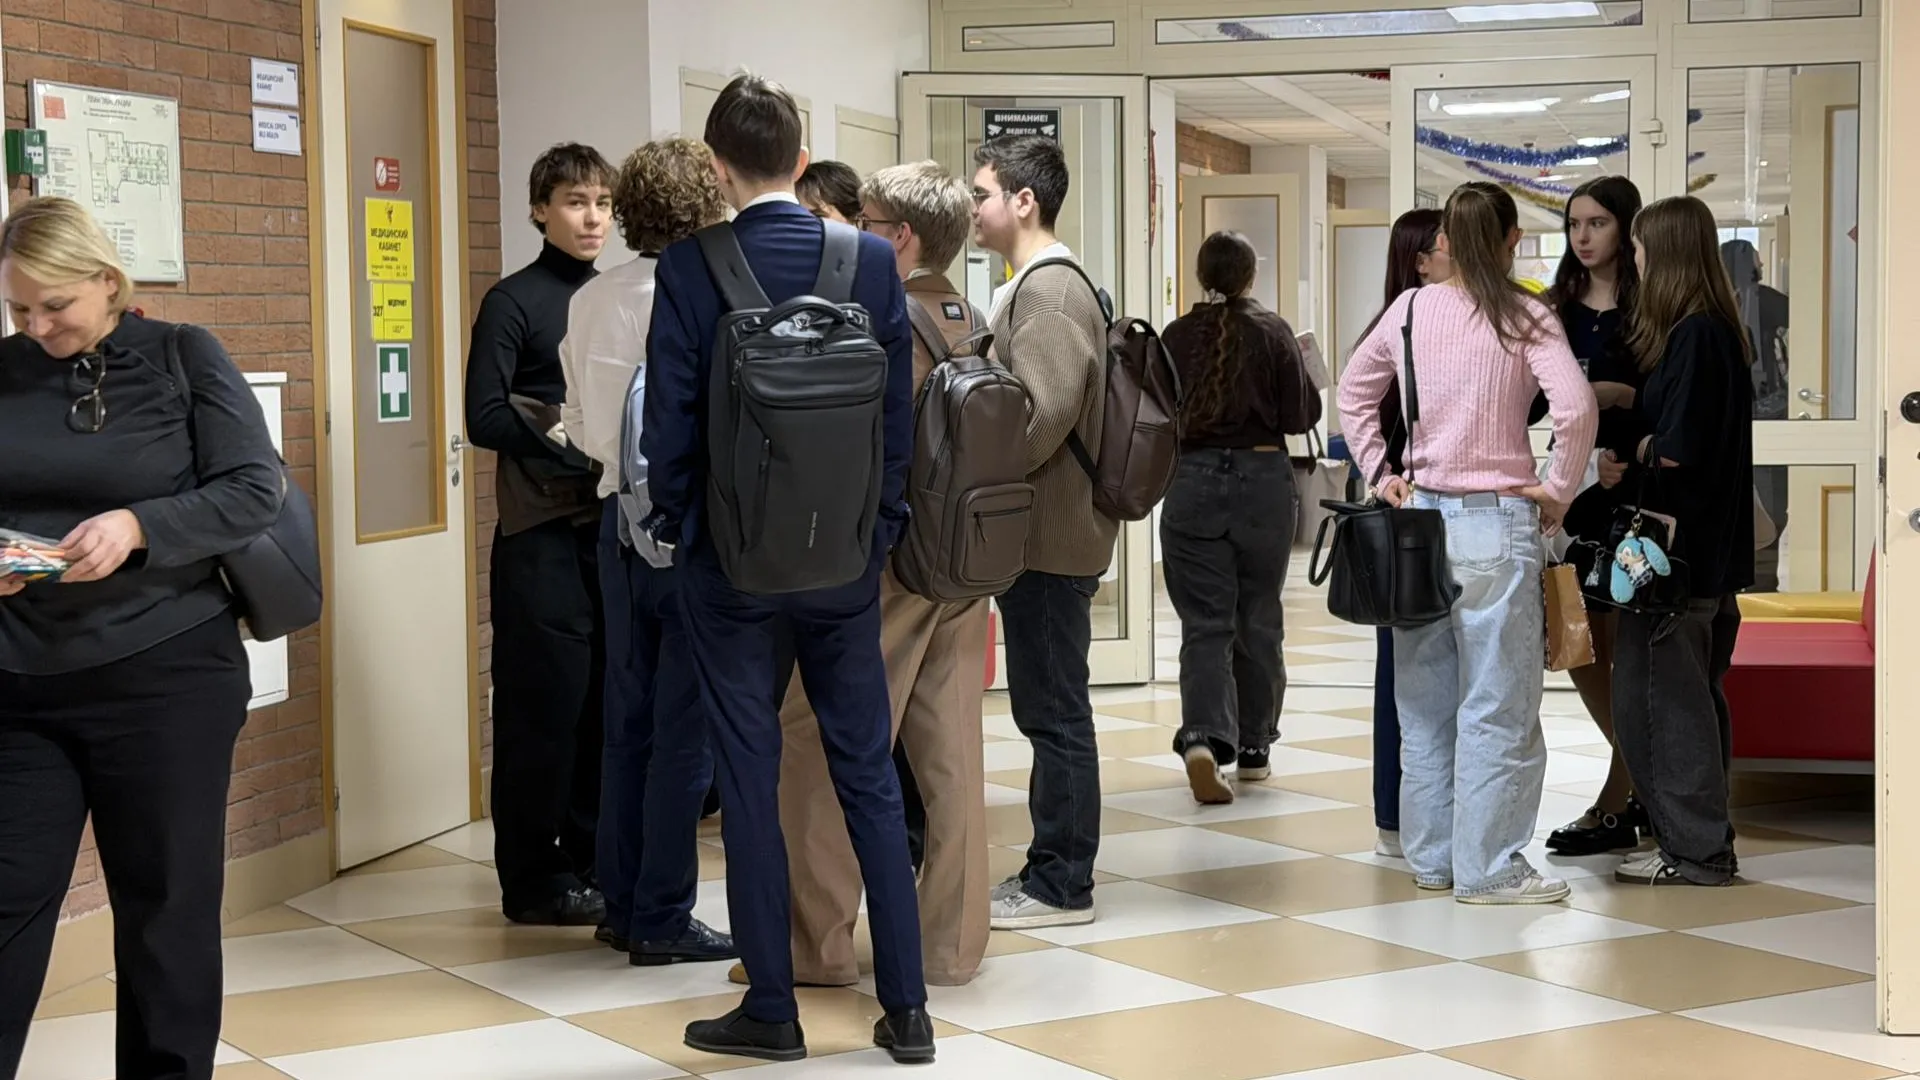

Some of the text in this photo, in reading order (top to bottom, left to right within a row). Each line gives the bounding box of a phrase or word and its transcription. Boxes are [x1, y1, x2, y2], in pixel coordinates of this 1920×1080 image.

[994, 114, 1048, 123] ВНИМАНИЕ!
[1006, 127, 1037, 135] ВЕДЕТСЯ
[370, 227, 409, 239] МЕДИЦИНСКИЙ
[378, 242, 402, 252] КАБИНЕТ
[373, 305, 384, 317] 327
